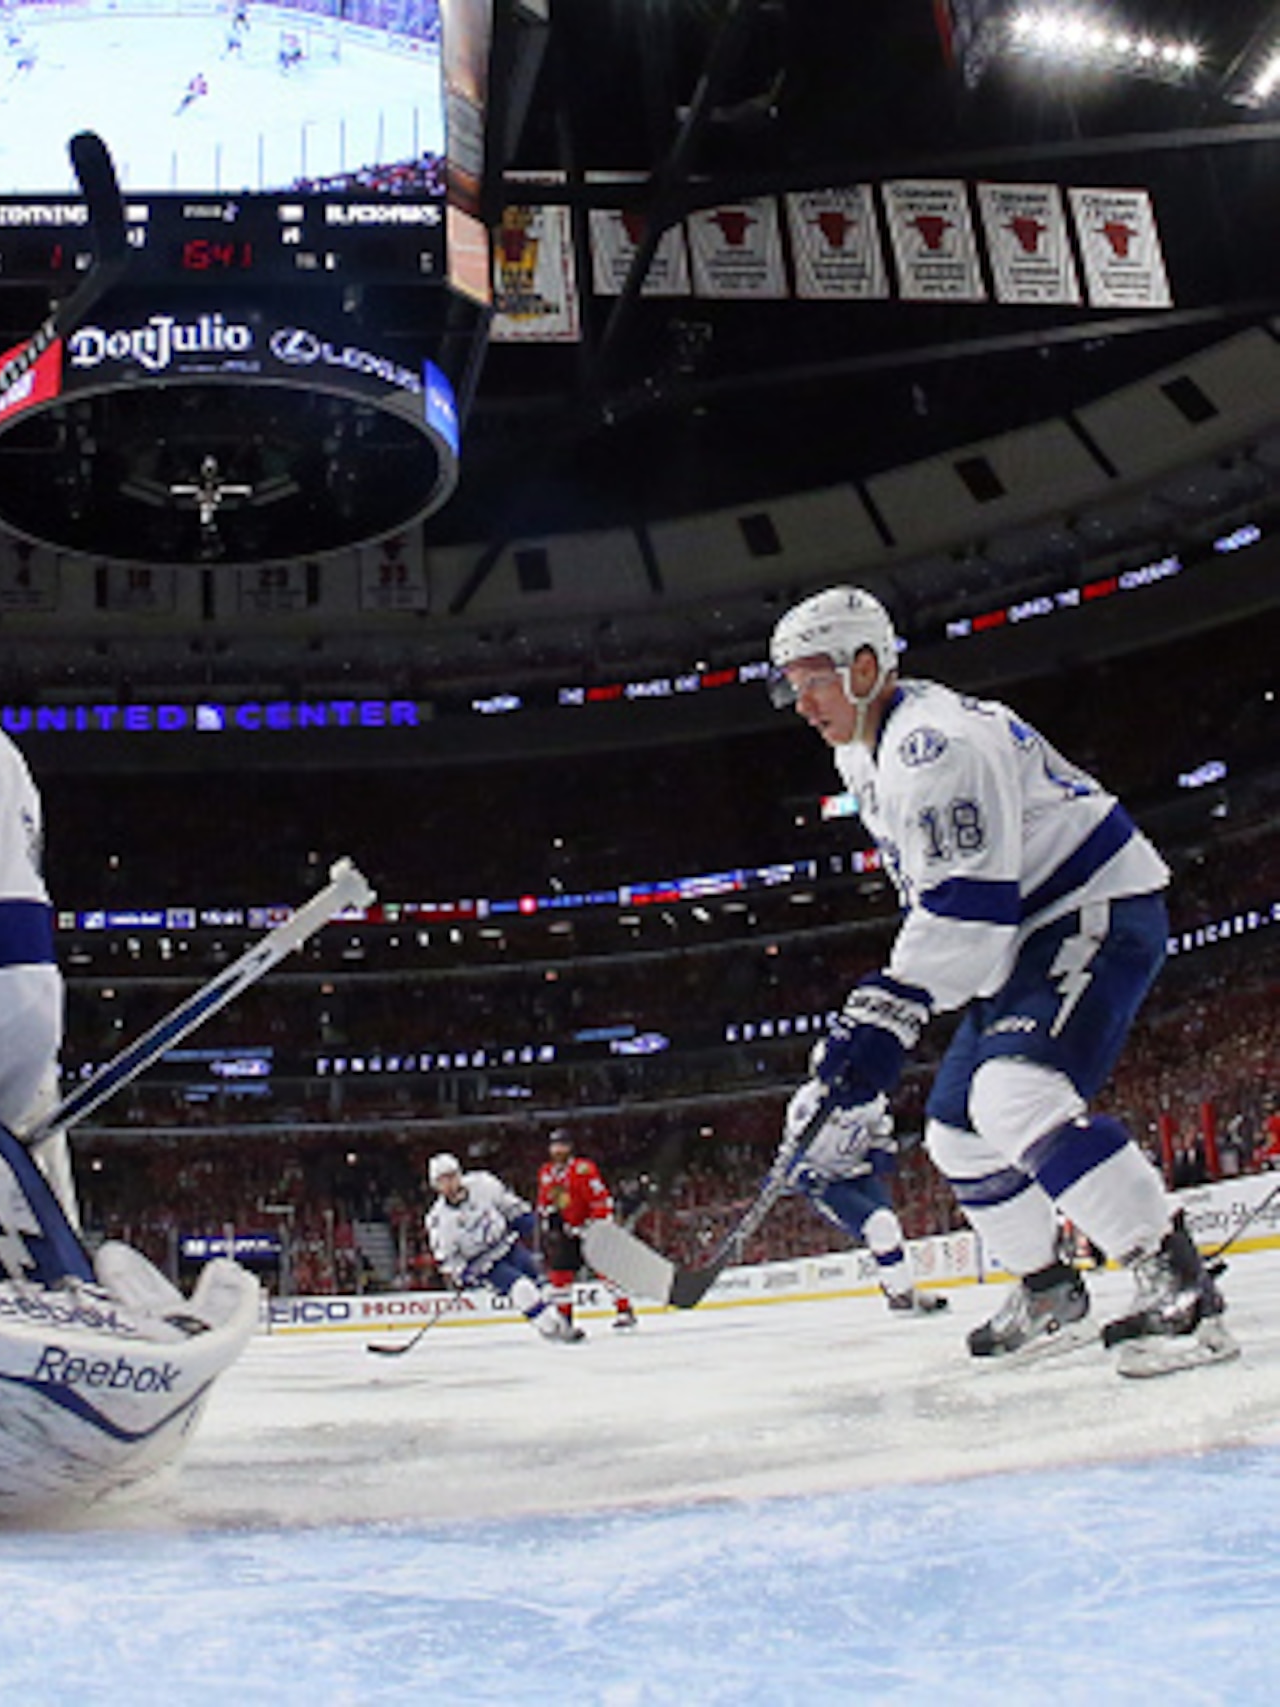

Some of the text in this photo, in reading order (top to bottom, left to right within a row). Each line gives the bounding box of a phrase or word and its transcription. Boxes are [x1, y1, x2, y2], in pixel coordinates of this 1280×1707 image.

[0, 700, 421, 733] UNITED CENTER
[917, 797, 987, 866] 18
[361, 1297, 477, 1318] HONDA
[33, 1344, 182, 1393] Reebok
